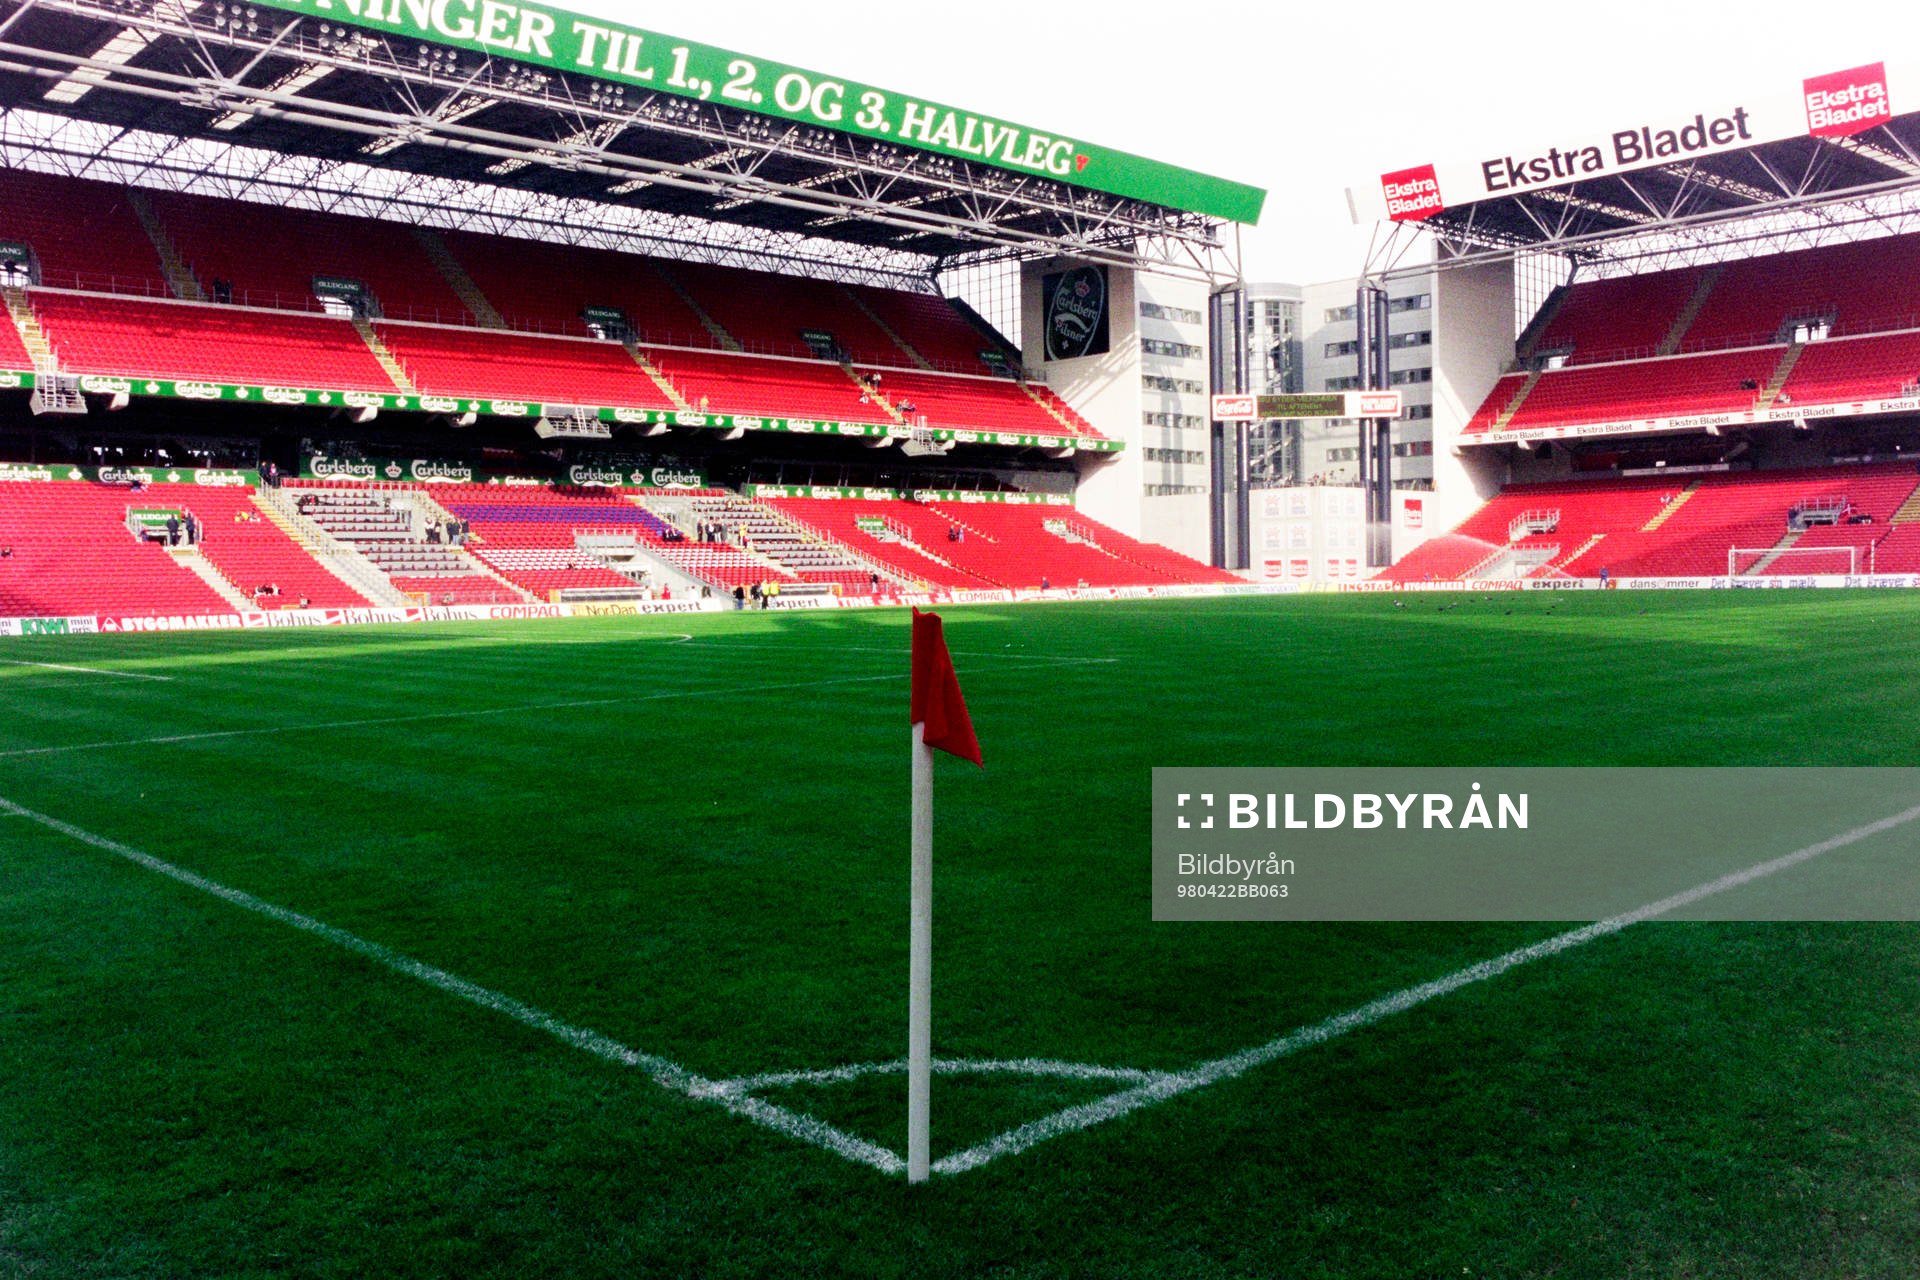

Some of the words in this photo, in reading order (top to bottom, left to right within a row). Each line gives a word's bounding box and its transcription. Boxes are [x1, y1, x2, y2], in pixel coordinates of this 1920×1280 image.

[573, 21, 654, 80] TIL
[721, 59, 762, 103] 2.
[774, 73, 844, 121] OG
[854, 91, 890, 132] 3.
[898, 102, 1074, 175] HALVLEG
[1806, 81, 1886, 112] Ekstra
[1808, 96, 1889, 129] Bladet
[1481, 143, 1605, 192] Ekstra
[1611, 106, 1753, 165] Bladet
[1384, 179, 1437, 199] Ekstra
[1387, 192, 1441, 215] Bladet
[1056, 286, 1098, 320] Carlsberg
[1055, 321, 1085, 341] Pilsner
[1768, 410, 1800, 420] Ekstra
[1802, 406, 1835, 417] Bladet
[1880, 401, 1915, 410] Ekstra
[1576, 426, 1604, 435] Ekstra
[1605, 423, 1633, 432] Bladet
[1669, 418, 1698, 428] Ekstra
[1699, 415, 1730, 425] Bladet
[99, 466, 153, 484] Carlsberg
[310, 456, 376, 480] Carlsberg
[411, 459, 472, 483] Carlsberg
[569, 464, 623, 488] Carlsberg
[194, 469, 245, 486] Carlsberg
[651, 467, 701, 489] Carlsberg
[1471, 580, 1524, 591] COMPAQ
[1532, 579, 1584, 590] expert
[641, 601, 702, 613] expert
[774, 597, 820, 609] xpert
[266, 611, 322, 627] Bohus
[343, 609, 402, 624] Bohus
[423, 606, 478, 622] Bohus
[489, 605, 563, 619] COMPAQ
[20, 618, 70, 635] KIWI
[70, 618, 93, 626] mini
[120, 614, 243, 631] BYGGMAKKER
